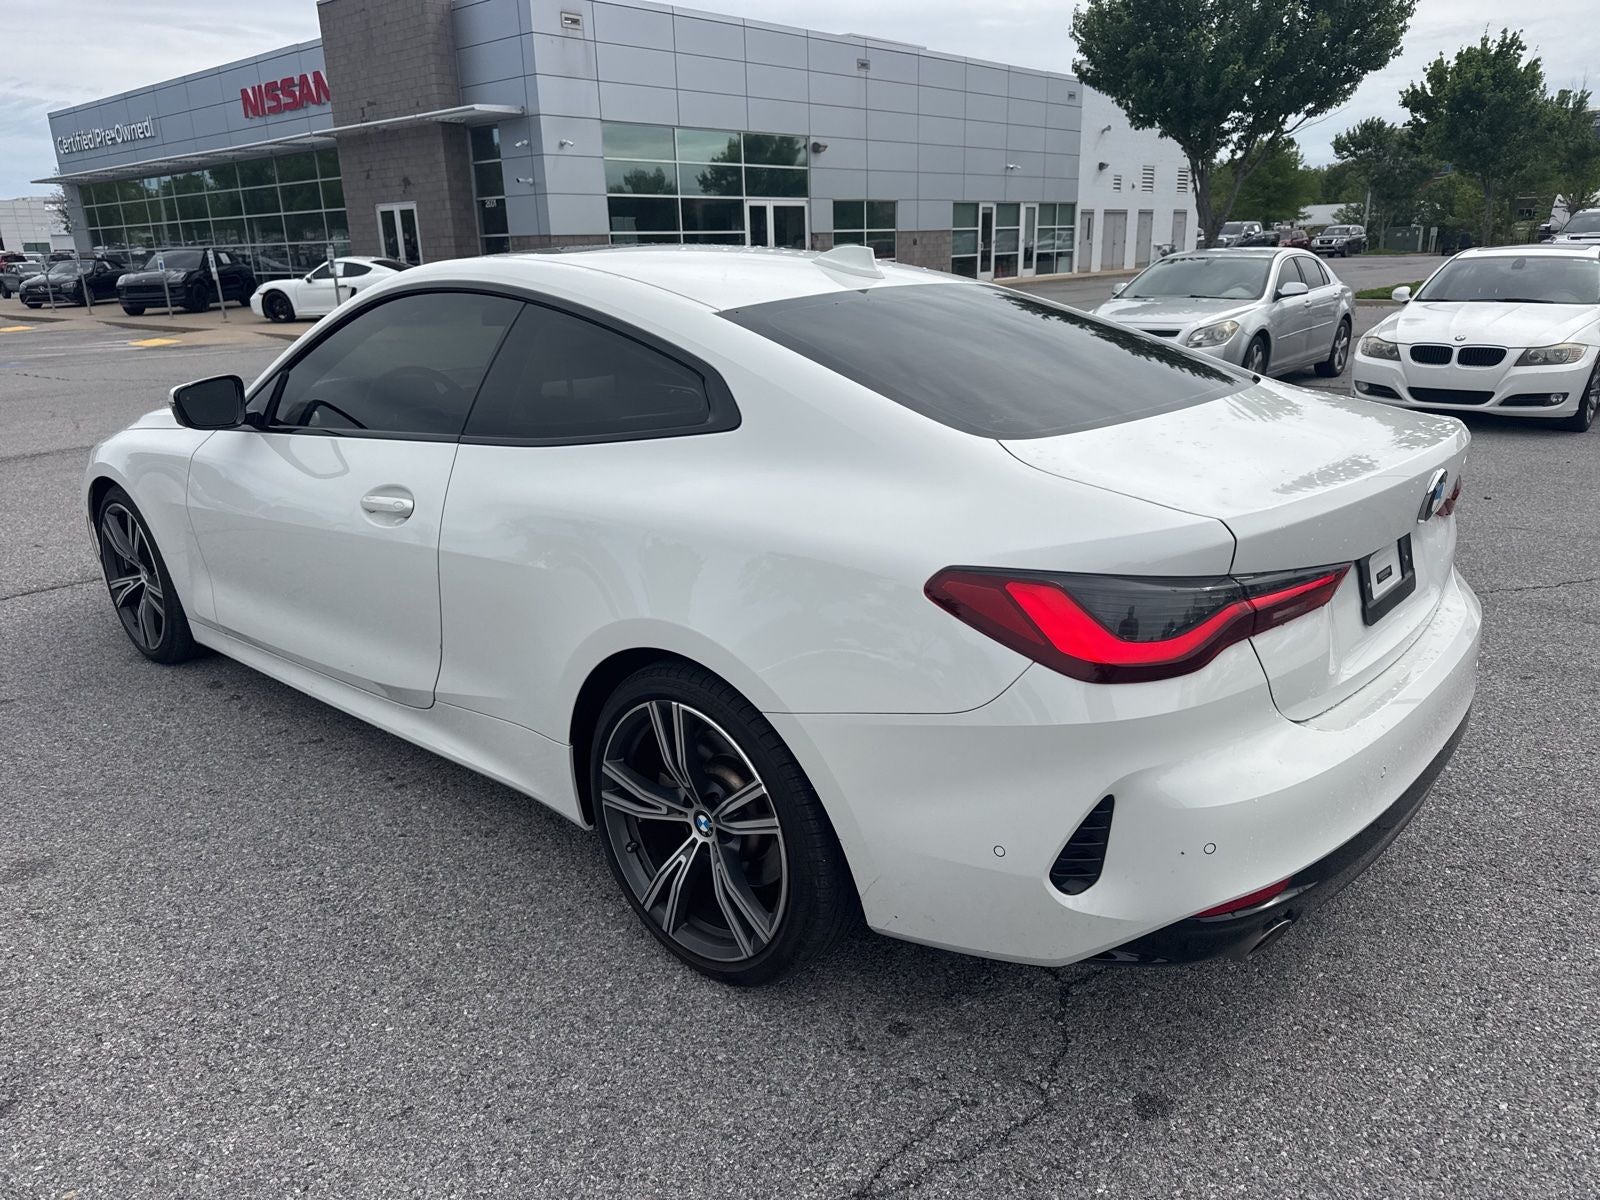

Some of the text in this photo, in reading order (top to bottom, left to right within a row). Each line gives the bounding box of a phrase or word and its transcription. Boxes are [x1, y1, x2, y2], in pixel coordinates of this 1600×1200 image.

[240, 70, 331, 119] NISSAN
[57, 115, 155, 154] Certified Pre-Owned
